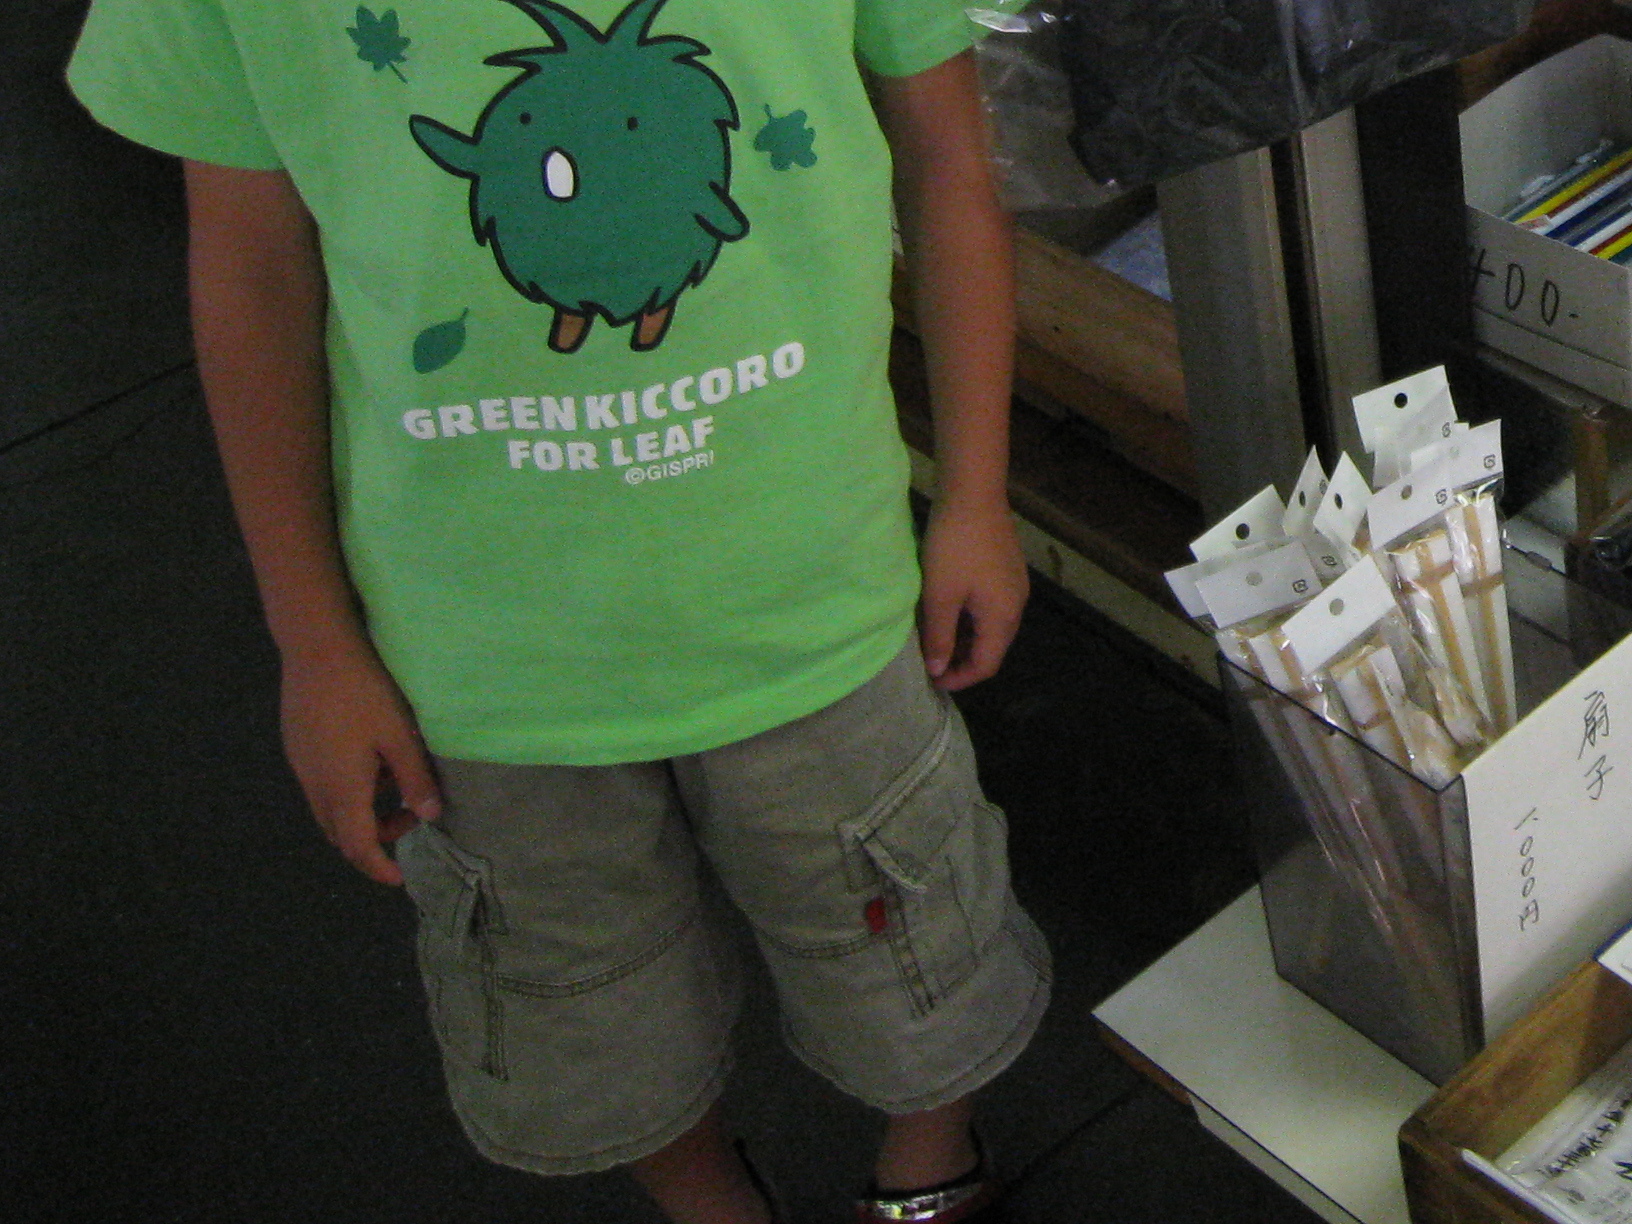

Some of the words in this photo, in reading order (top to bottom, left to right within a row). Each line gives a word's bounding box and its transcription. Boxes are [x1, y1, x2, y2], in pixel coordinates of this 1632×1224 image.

[402, 394, 579, 443] GREEN
[583, 340, 806, 432] KICCORO
[506, 439, 600, 473] FOR
[609, 414, 717, 468] LEAF
